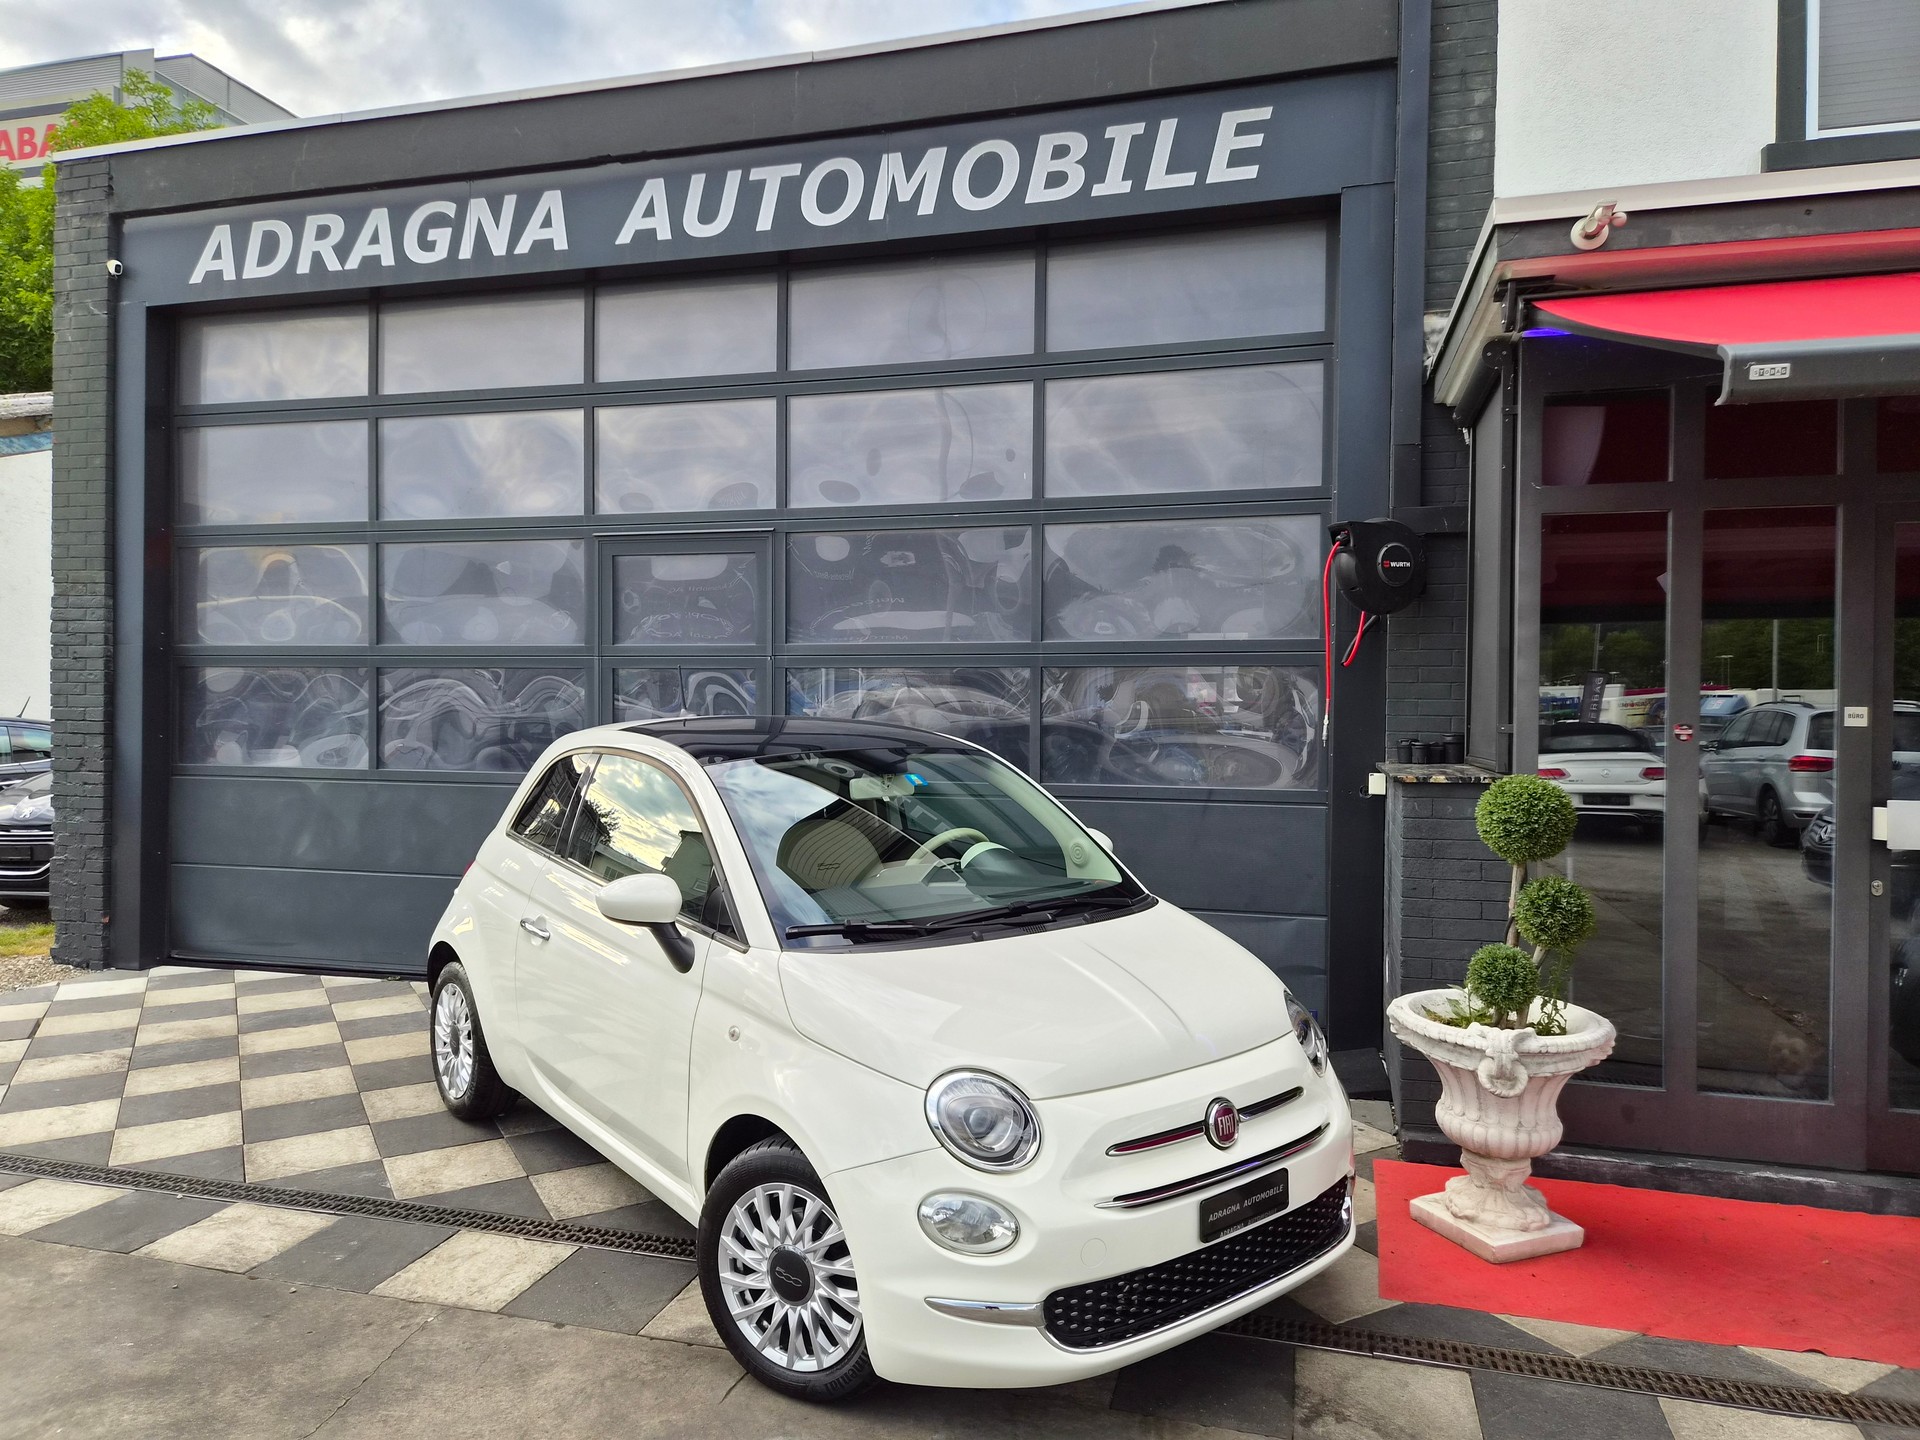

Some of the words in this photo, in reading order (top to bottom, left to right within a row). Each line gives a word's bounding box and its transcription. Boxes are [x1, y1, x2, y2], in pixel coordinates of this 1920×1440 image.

[189, 190, 569, 284] ADRAGNA
[615, 107, 1274, 245] AUTOMOBILE
[1217, 1114, 1234, 1136] FIAT
[1208, 1203, 1241, 1222] ADRAGNA
[1243, 1184, 1284, 1208] AUTOMOBILE
[775, 1267, 803, 1287] 500
